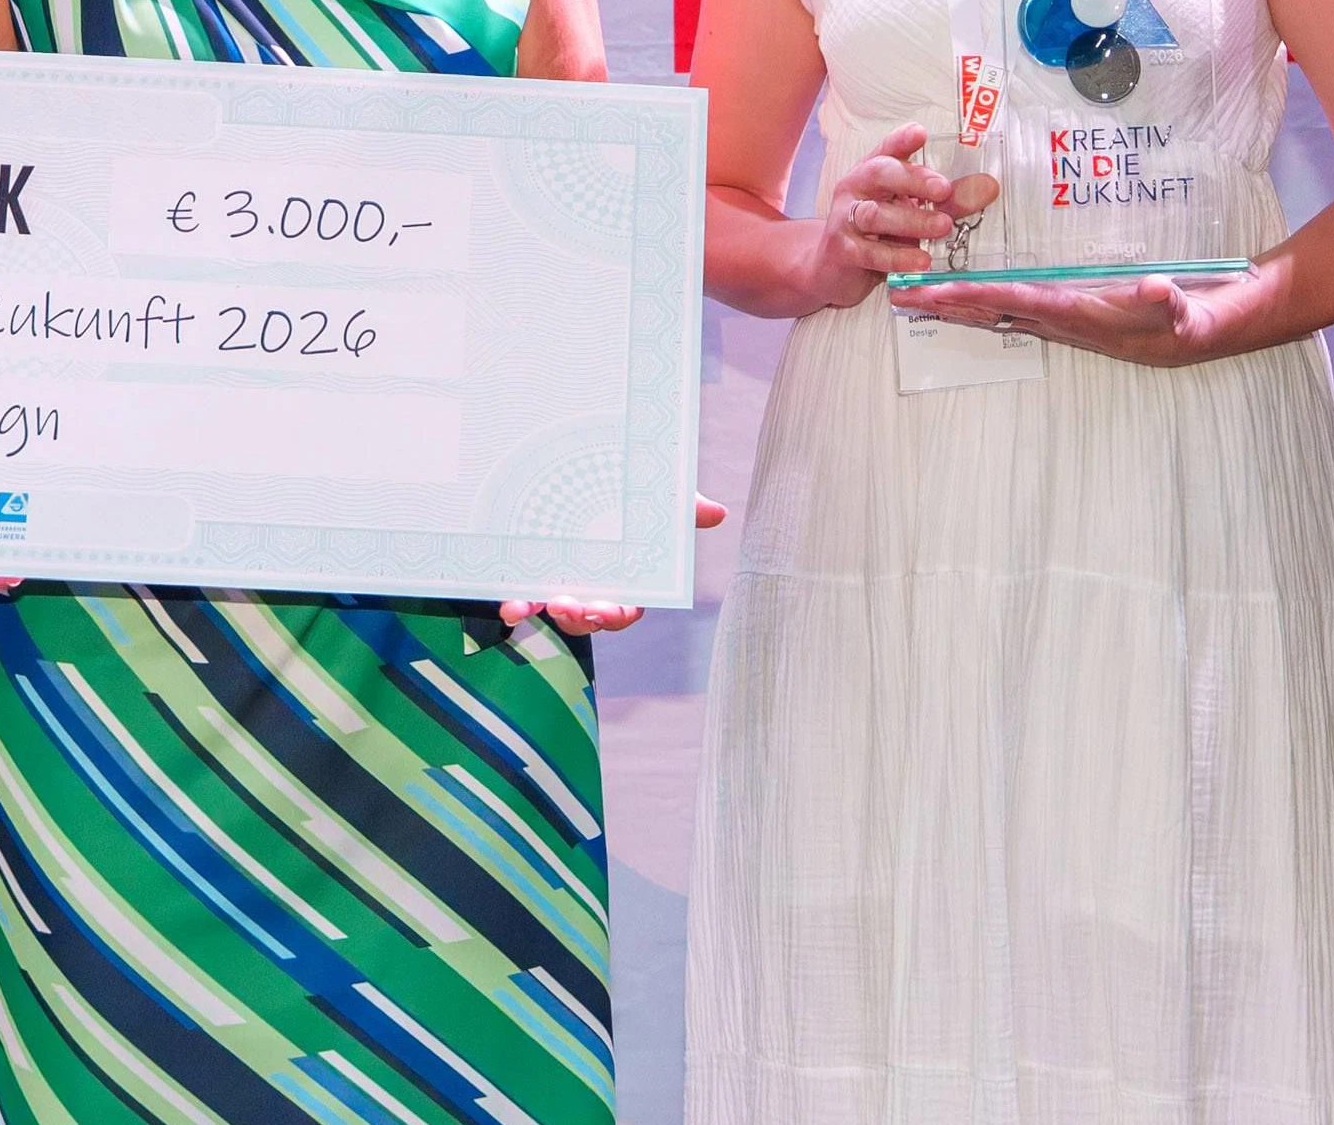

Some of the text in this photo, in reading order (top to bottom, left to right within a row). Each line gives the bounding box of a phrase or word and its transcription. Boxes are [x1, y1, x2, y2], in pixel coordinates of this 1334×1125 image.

[1050, 125, 1172, 153] KREATIV
[1052, 153, 1140, 179] IN DIE
[1052, 177, 1195, 207] ZUKUNFT
[166, 191, 200, 233] €
[218, 307, 377, 357] 2026
[908, 314, 940, 324] Bettina
[909, 328, 938, 338] Design
